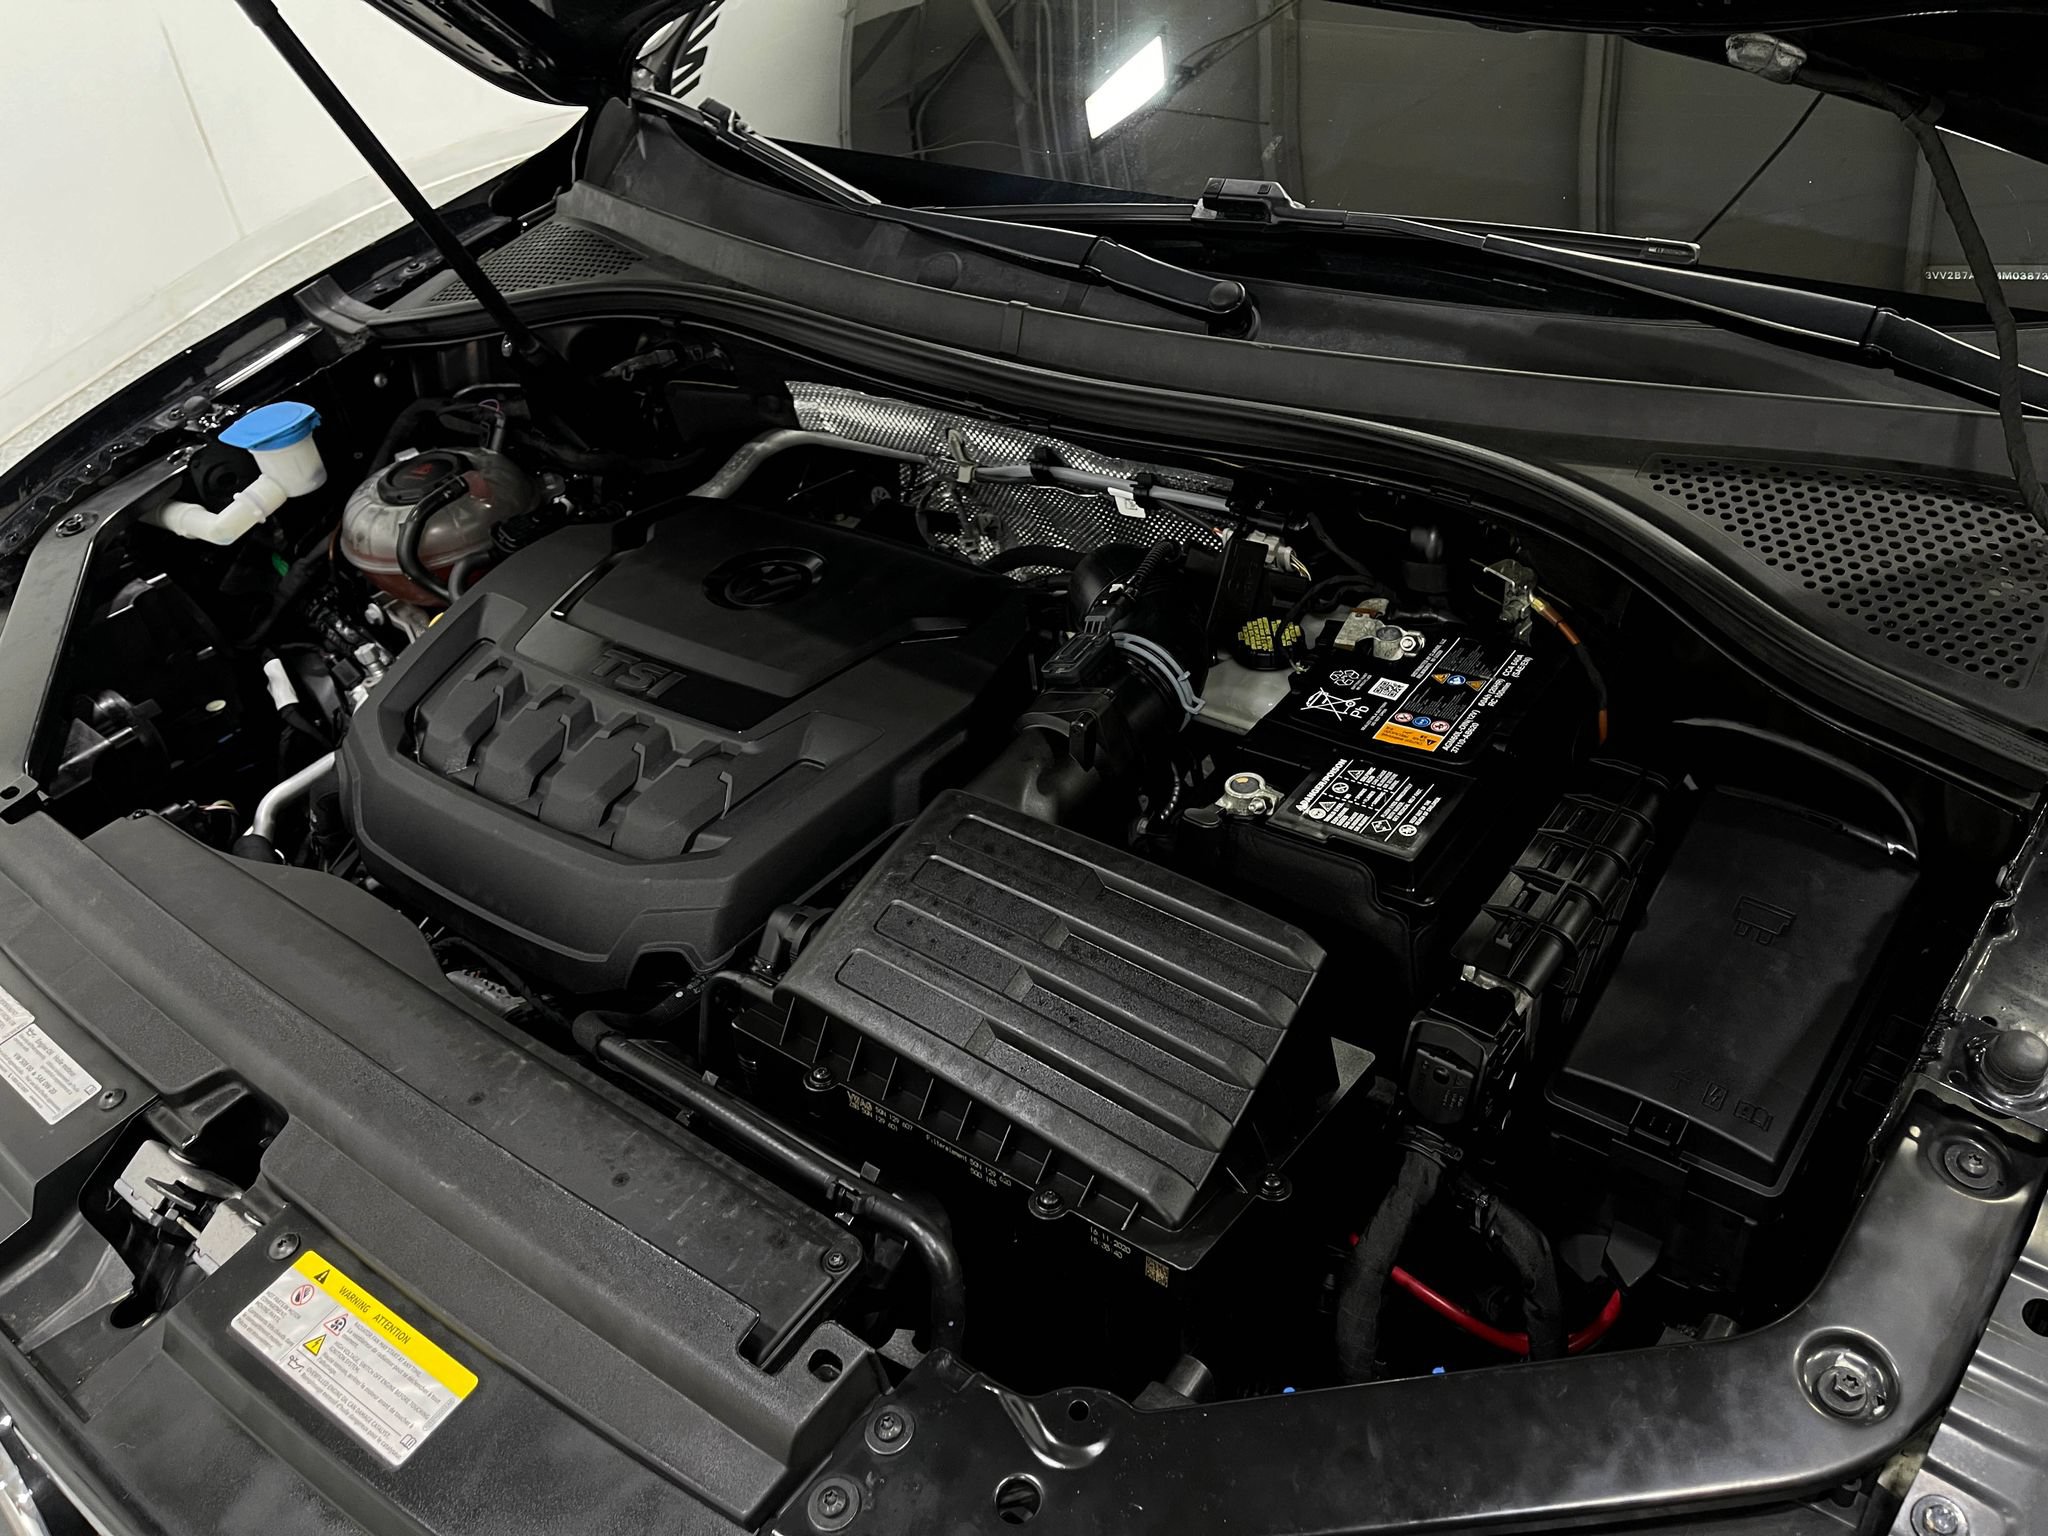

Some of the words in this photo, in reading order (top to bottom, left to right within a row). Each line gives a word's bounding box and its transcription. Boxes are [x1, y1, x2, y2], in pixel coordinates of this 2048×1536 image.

[592, 649, 688, 699] TSI
[1350, 706, 1369, 719] Pb
[337, 1285, 371, 1313] WARNING
[371, 1312, 411, 1344] ATTENTION
[371, 1371, 382, 1381] OFF
[379, 1377, 396, 1392] ENGINE
